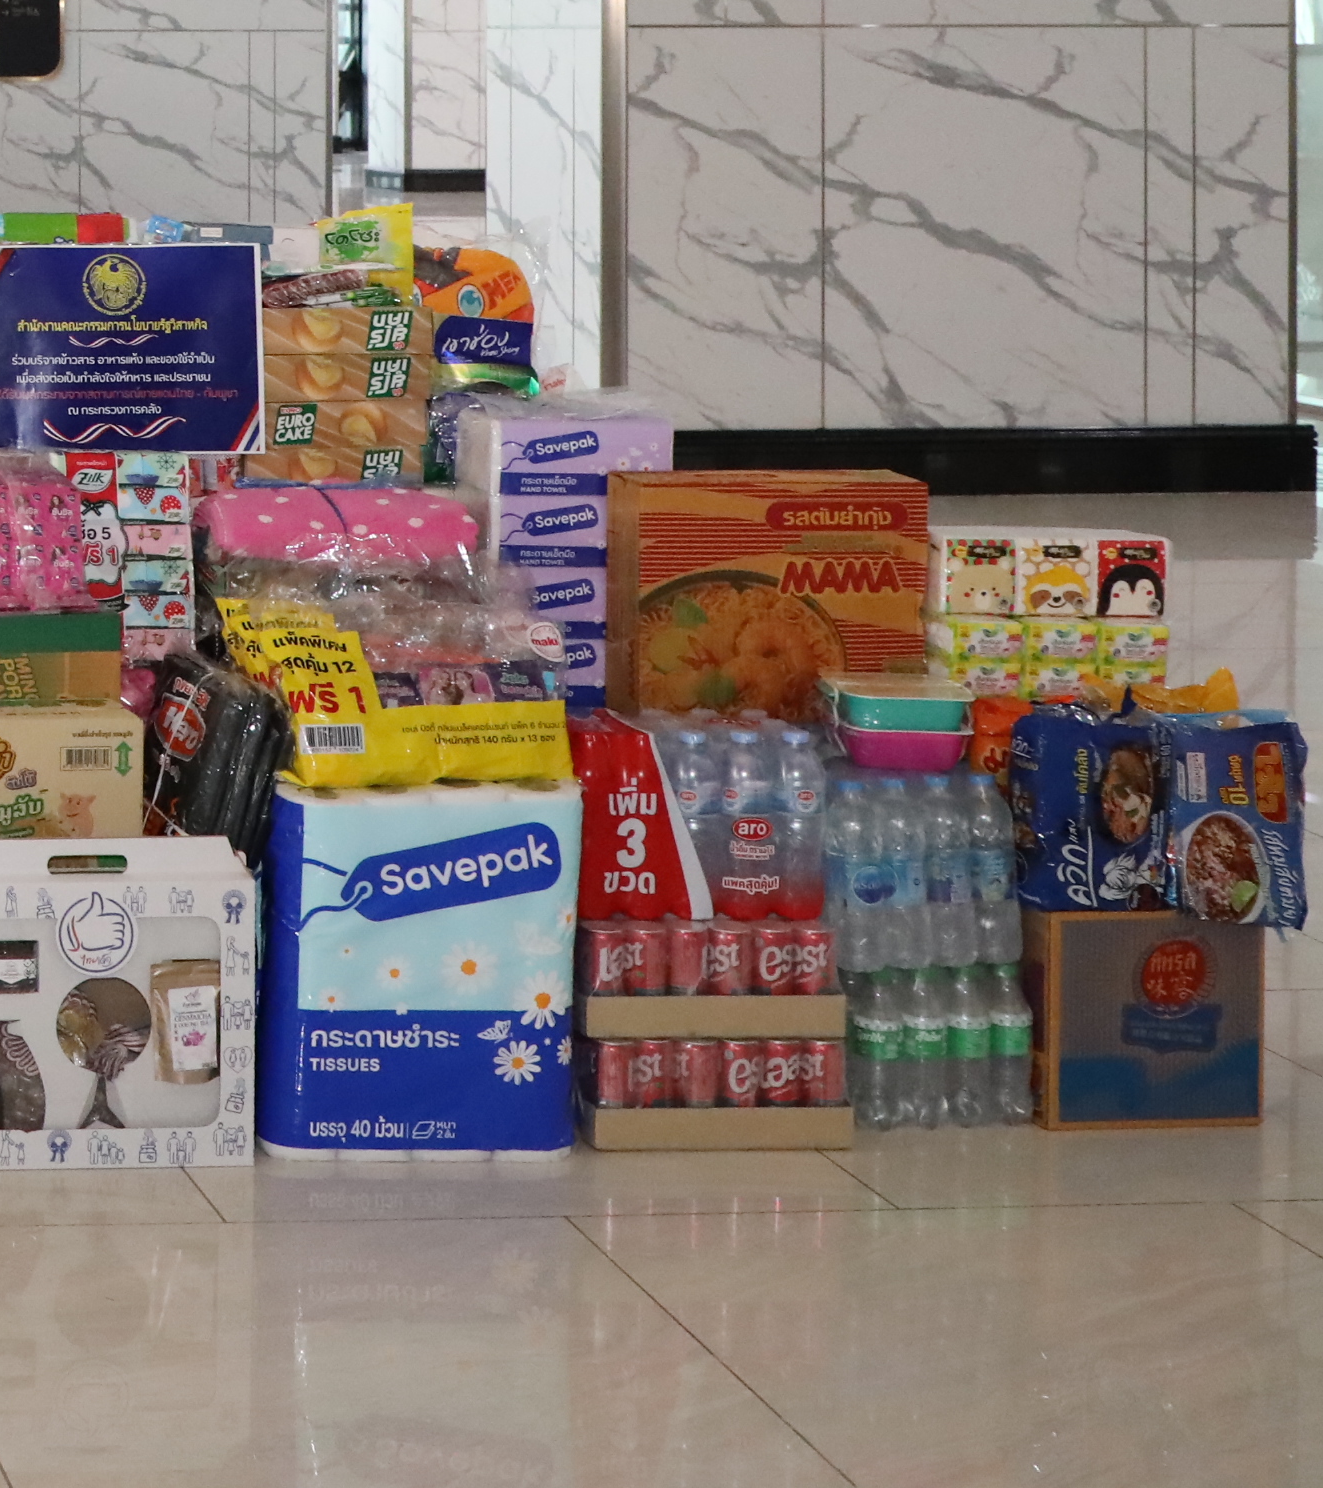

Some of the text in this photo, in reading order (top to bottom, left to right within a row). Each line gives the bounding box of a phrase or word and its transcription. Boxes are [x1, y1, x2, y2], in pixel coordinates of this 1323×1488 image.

[17, 315, 208, 335] สำนักงานคณะกรรมการนโยบายรัฐวิสาหกิจ
[12, 352, 215, 366] ร่วมบริจาคข้าวสาร อาหารแห้ง และของใช้จำเป็น
[16, 370, 211, 384] เพื่อส่งต่อเป็นกำลังใจให้ทหาร และประชาชน
[81, 403, 162, 416] กระทรวงการคลัง
[277, 413, 315, 428] EURO
[275, 427, 313, 443] CAKE
[535, 433, 597, 456] Savepak
[76, 472, 107, 487] Zilk
[534, 507, 596, 529] Savepak
[779, 558, 902, 596] MAMA
[334, 660, 356, 674] 12
[288, 682, 368, 714] ฟรี 1
[482, 734, 499, 745] 140
[527, 734, 539, 744] 13
[607, 777, 658, 817] เพิ่ม
[737, 821, 768, 837] aro
[615, 817, 648, 869] 3
[379, 833, 555, 898] Savepak
[603, 870, 657, 896] ขวด
[309, 1025, 461, 1050] กระดาษชำระ
[309, 1057, 382, 1074] TISSUES
[308, 1115, 405, 1147] บรรจุ 40 ม้วน
